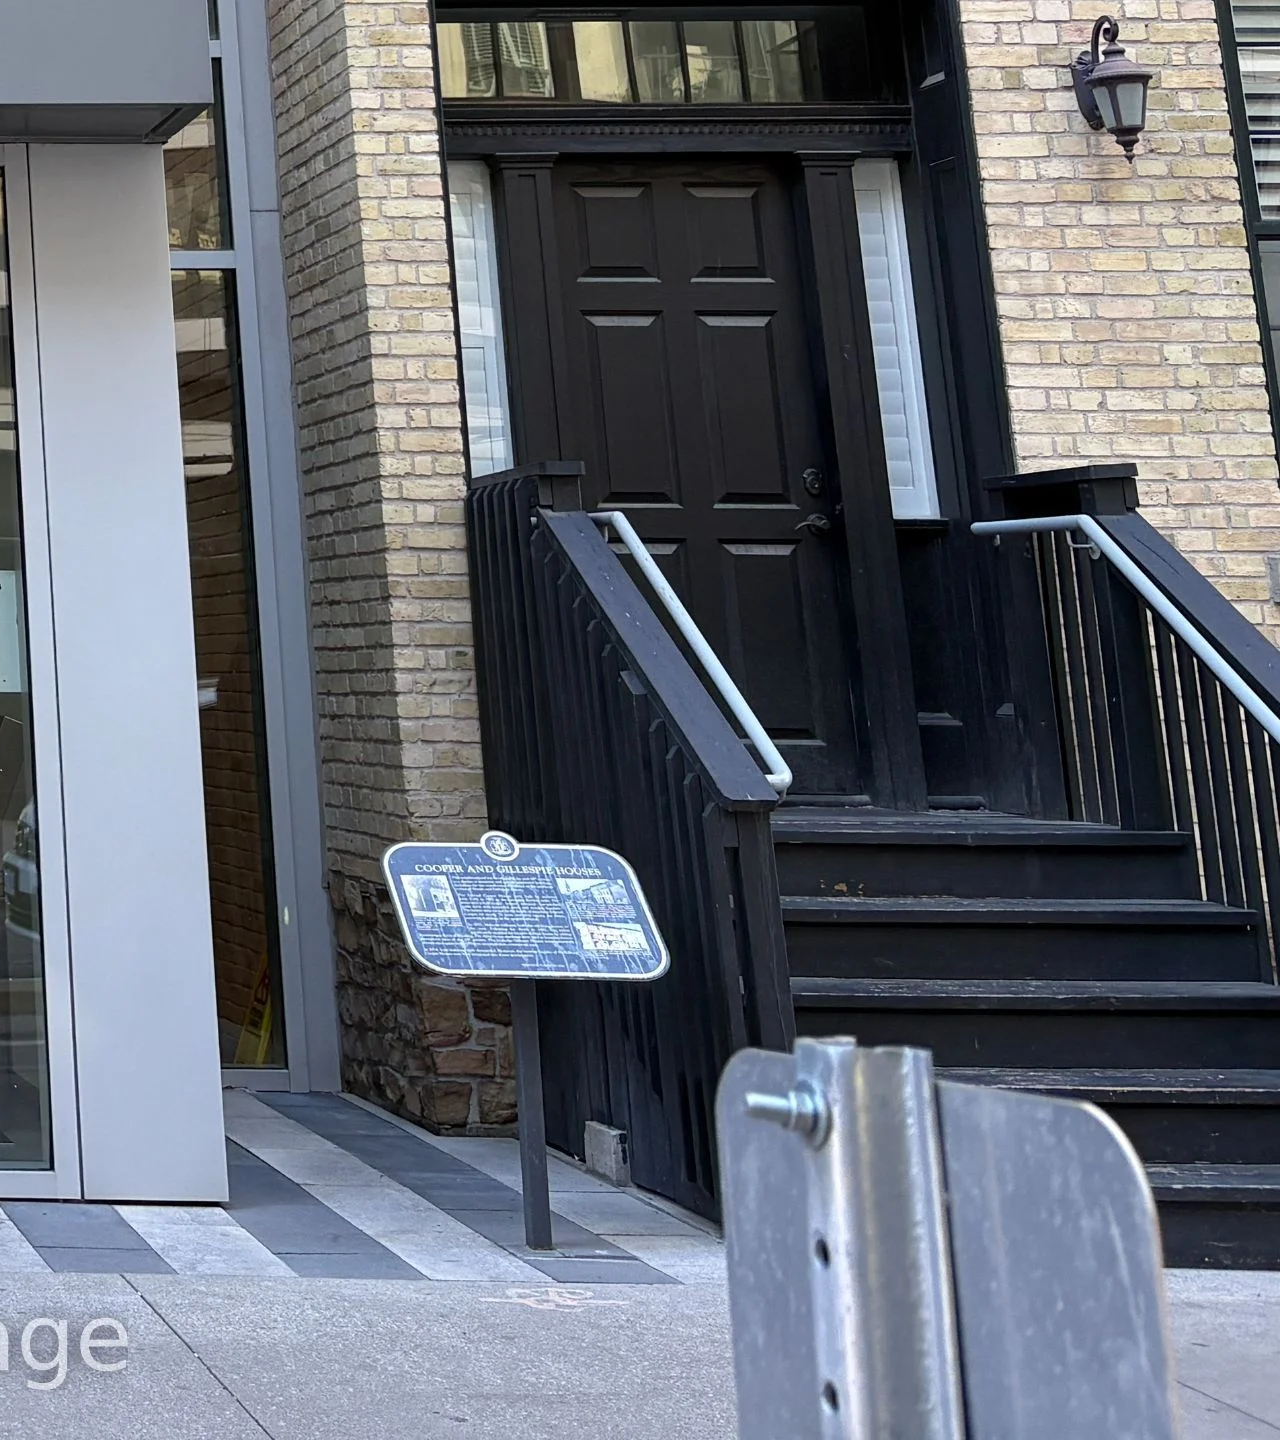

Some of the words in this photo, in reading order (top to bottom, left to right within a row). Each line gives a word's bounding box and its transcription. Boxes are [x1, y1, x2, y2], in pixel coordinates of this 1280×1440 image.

[414, 863, 464, 874] COOPER
[468, 864, 494, 874] AND
[496, 865, 554, 875] GILLESPIE
[557, 865, 602, 876] HOUSES
